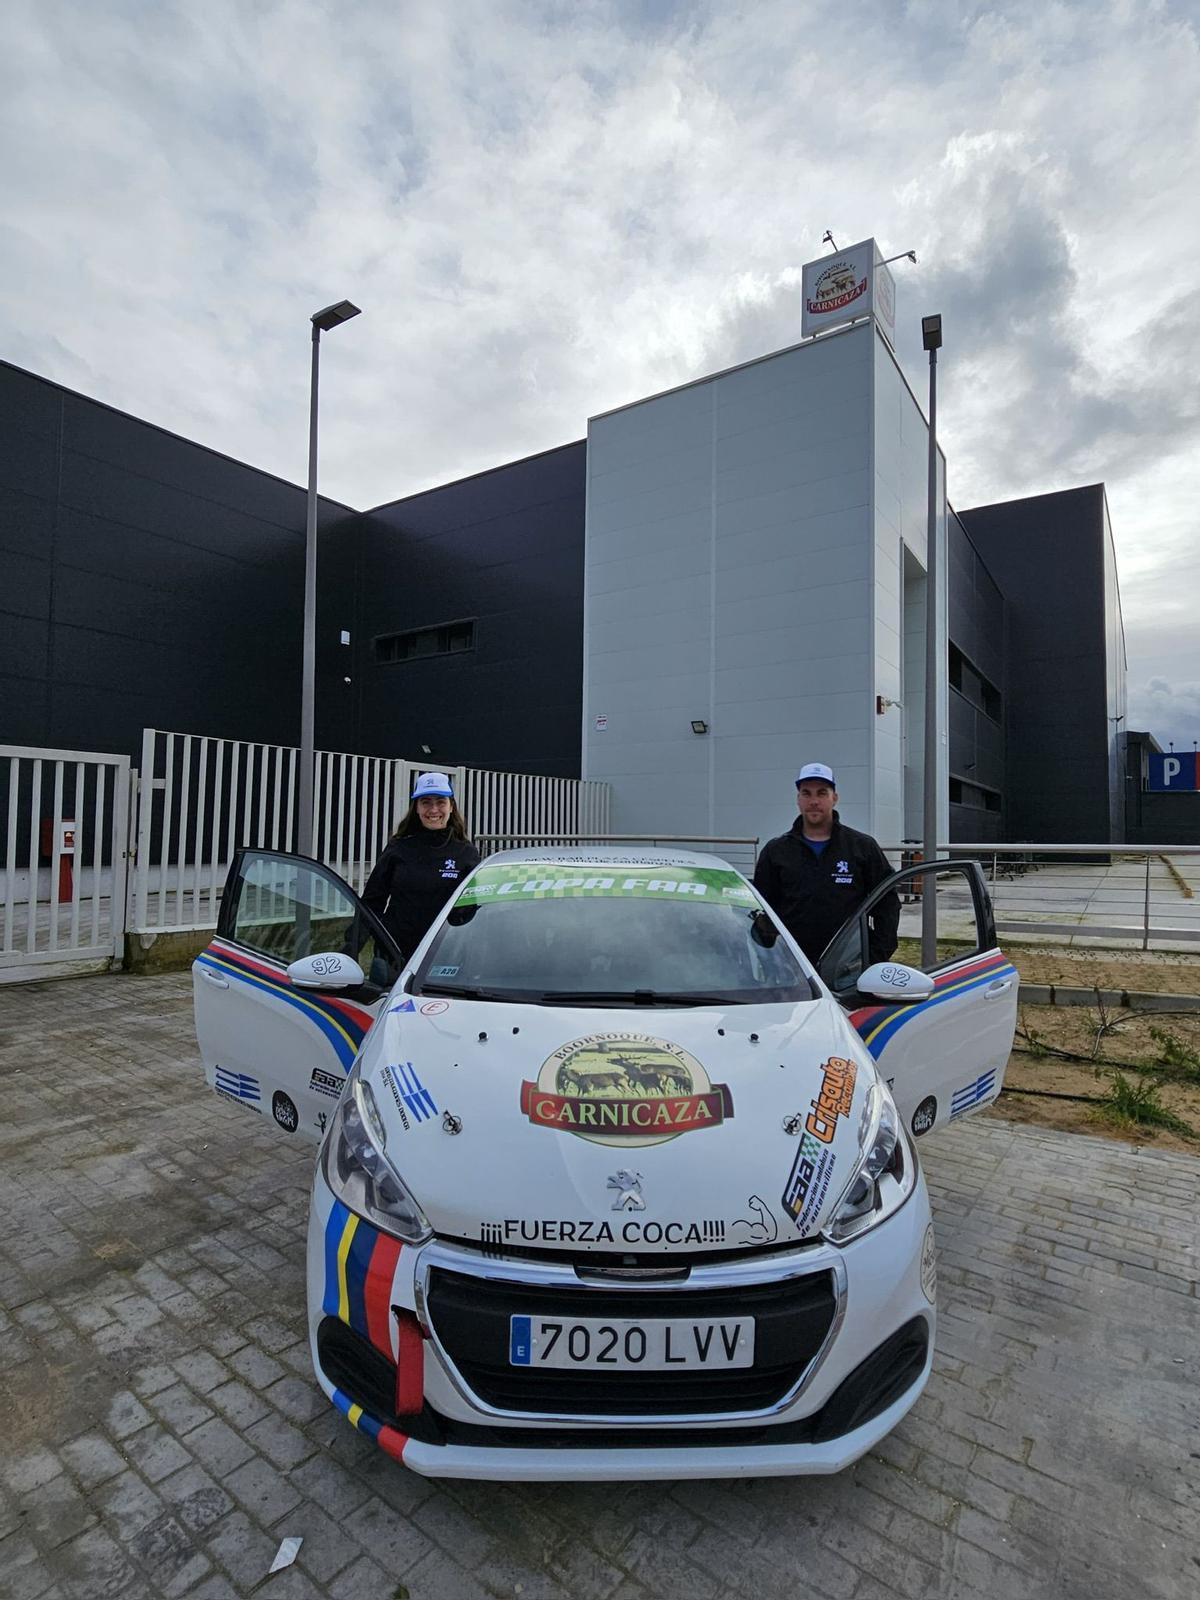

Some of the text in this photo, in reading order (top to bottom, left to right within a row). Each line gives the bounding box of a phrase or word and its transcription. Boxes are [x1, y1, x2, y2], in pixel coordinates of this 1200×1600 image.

[810, 287, 861, 310] CARNICAZA
[1163, 757, 1181, 786] P
[497, 878, 615, 895] COPA
[622, 879, 708, 896] FAA
[311, 956, 342, 975] 92
[880, 966, 911, 987] 92
[536, 1099, 713, 1126] CARNICAZA
[805, 1056, 848, 1145] Crisauto
[801, 1153, 837, 1238] de automovilismo
[622, 1220, 725, 1244] COCA!!!!
[517, 1346, 525, 1357] E
[540, 1323, 741, 1363] 7020 LVV
